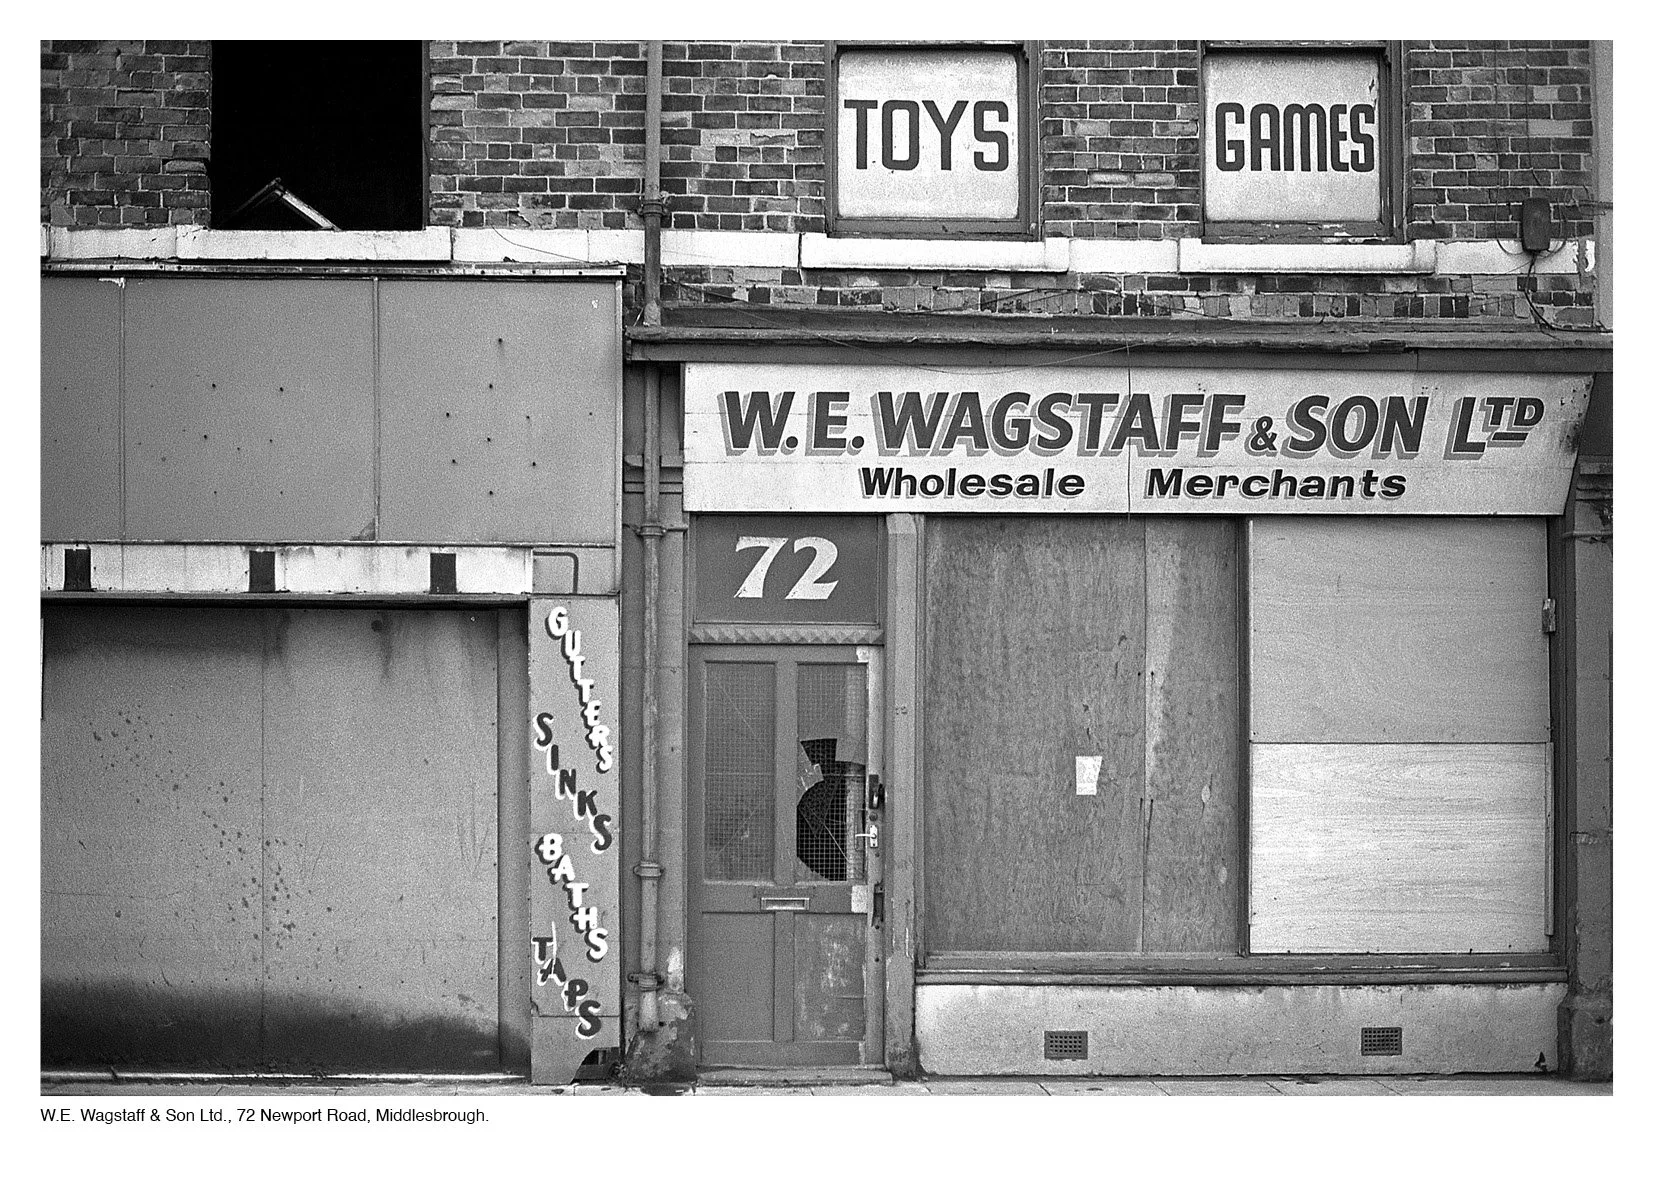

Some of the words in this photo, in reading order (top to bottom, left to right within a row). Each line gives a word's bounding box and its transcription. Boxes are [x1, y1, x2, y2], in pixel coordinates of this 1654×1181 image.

[843, 99, 1010, 171] TOYS
[1215, 102, 1376, 172] GAMES
[871, 391, 1246, 457] WAGSTAFF
[1247, 416, 1278, 456] &
[1282, 394, 1429, 459] SON
[859, 467, 1086, 499] Wholesale
[1144, 468, 1408, 499] Merchants
[733, 536, 840, 600] 72
[545, 606, 613, 774] GUTTERS
[533, 712, 613, 854] SINKS
[534, 833, 608, 963] BATHS
[531, 936, 602, 1040] TAPS
